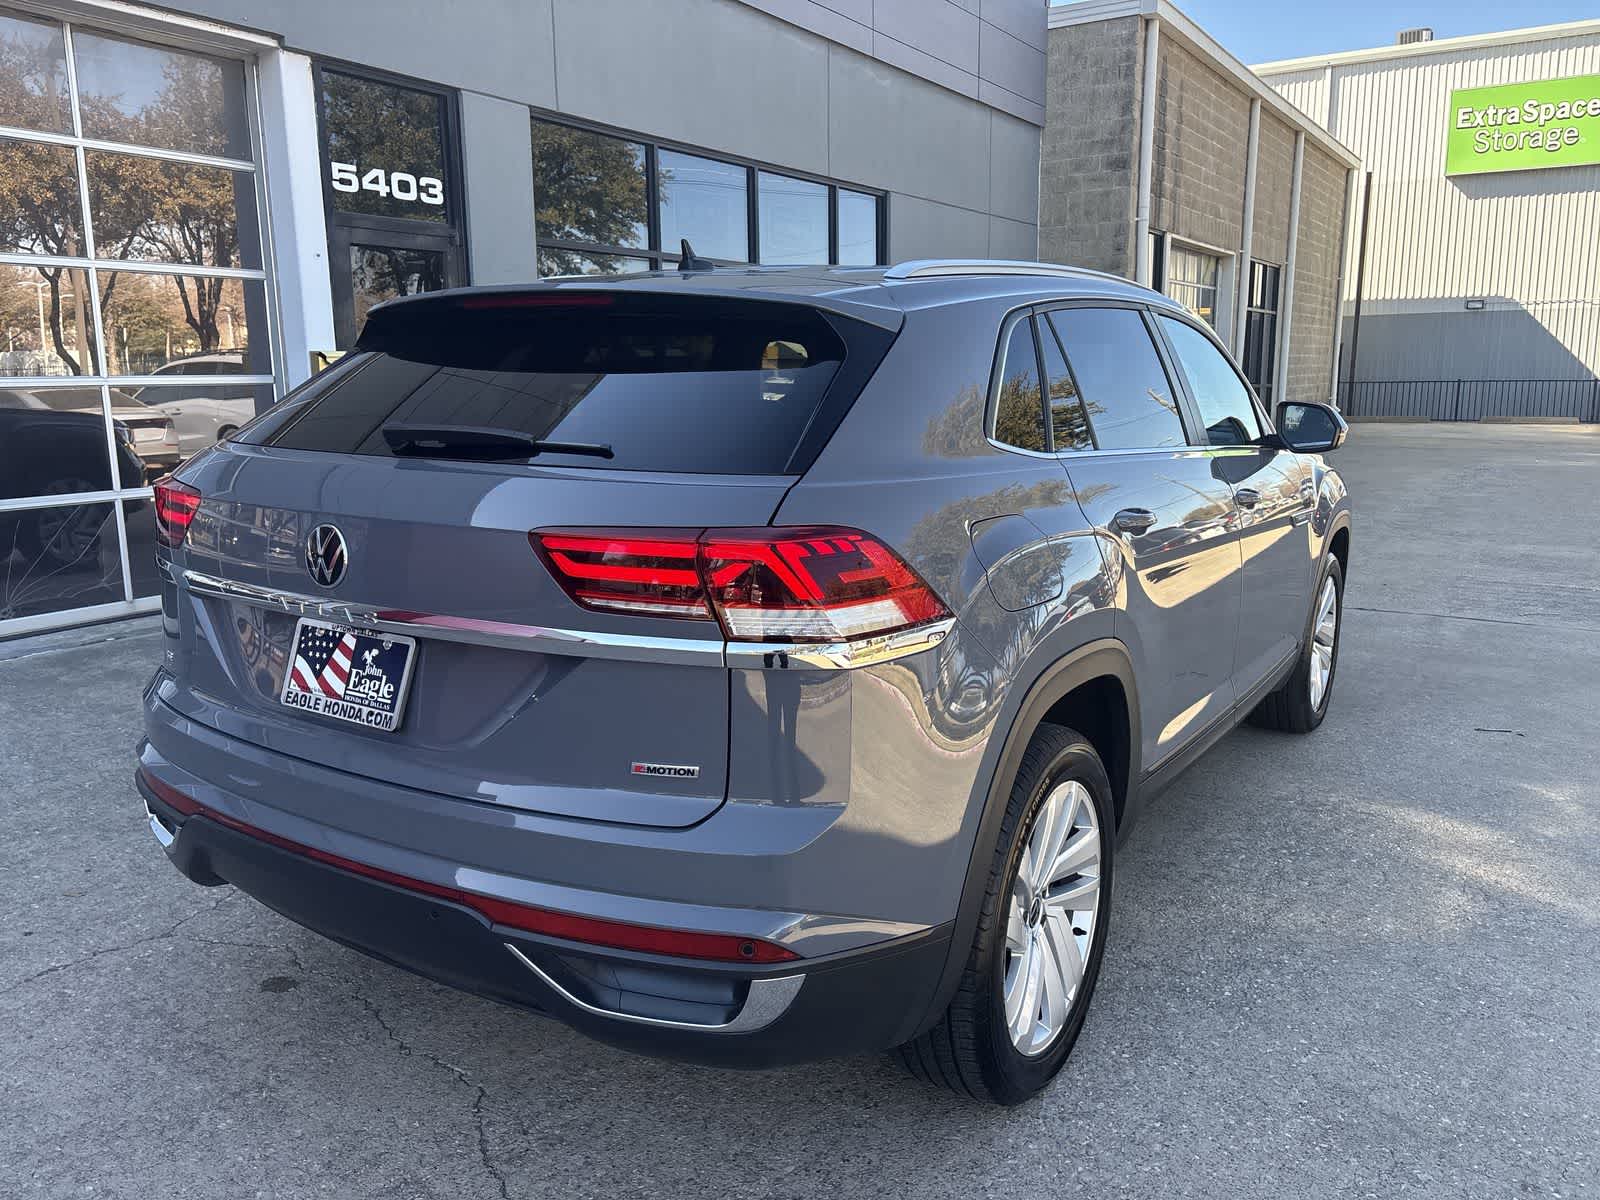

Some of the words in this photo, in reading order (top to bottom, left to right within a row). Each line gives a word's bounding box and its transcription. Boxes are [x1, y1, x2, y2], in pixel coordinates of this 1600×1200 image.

[1456, 104, 1520, 129] Extra
[1522, 98, 1600, 126] Space
[1473, 126, 1579, 153] Storage
[330, 161, 444, 205] 5403
[347, 668, 394, 701] Eagle
[362, 664, 383, 676] John
[285, 690, 320, 710] EAGLE
[323, 698, 393, 730] HONDA.COM
[344, 694, 362, 704] HONDA
[370, 701, 391, 711] DALLAS
